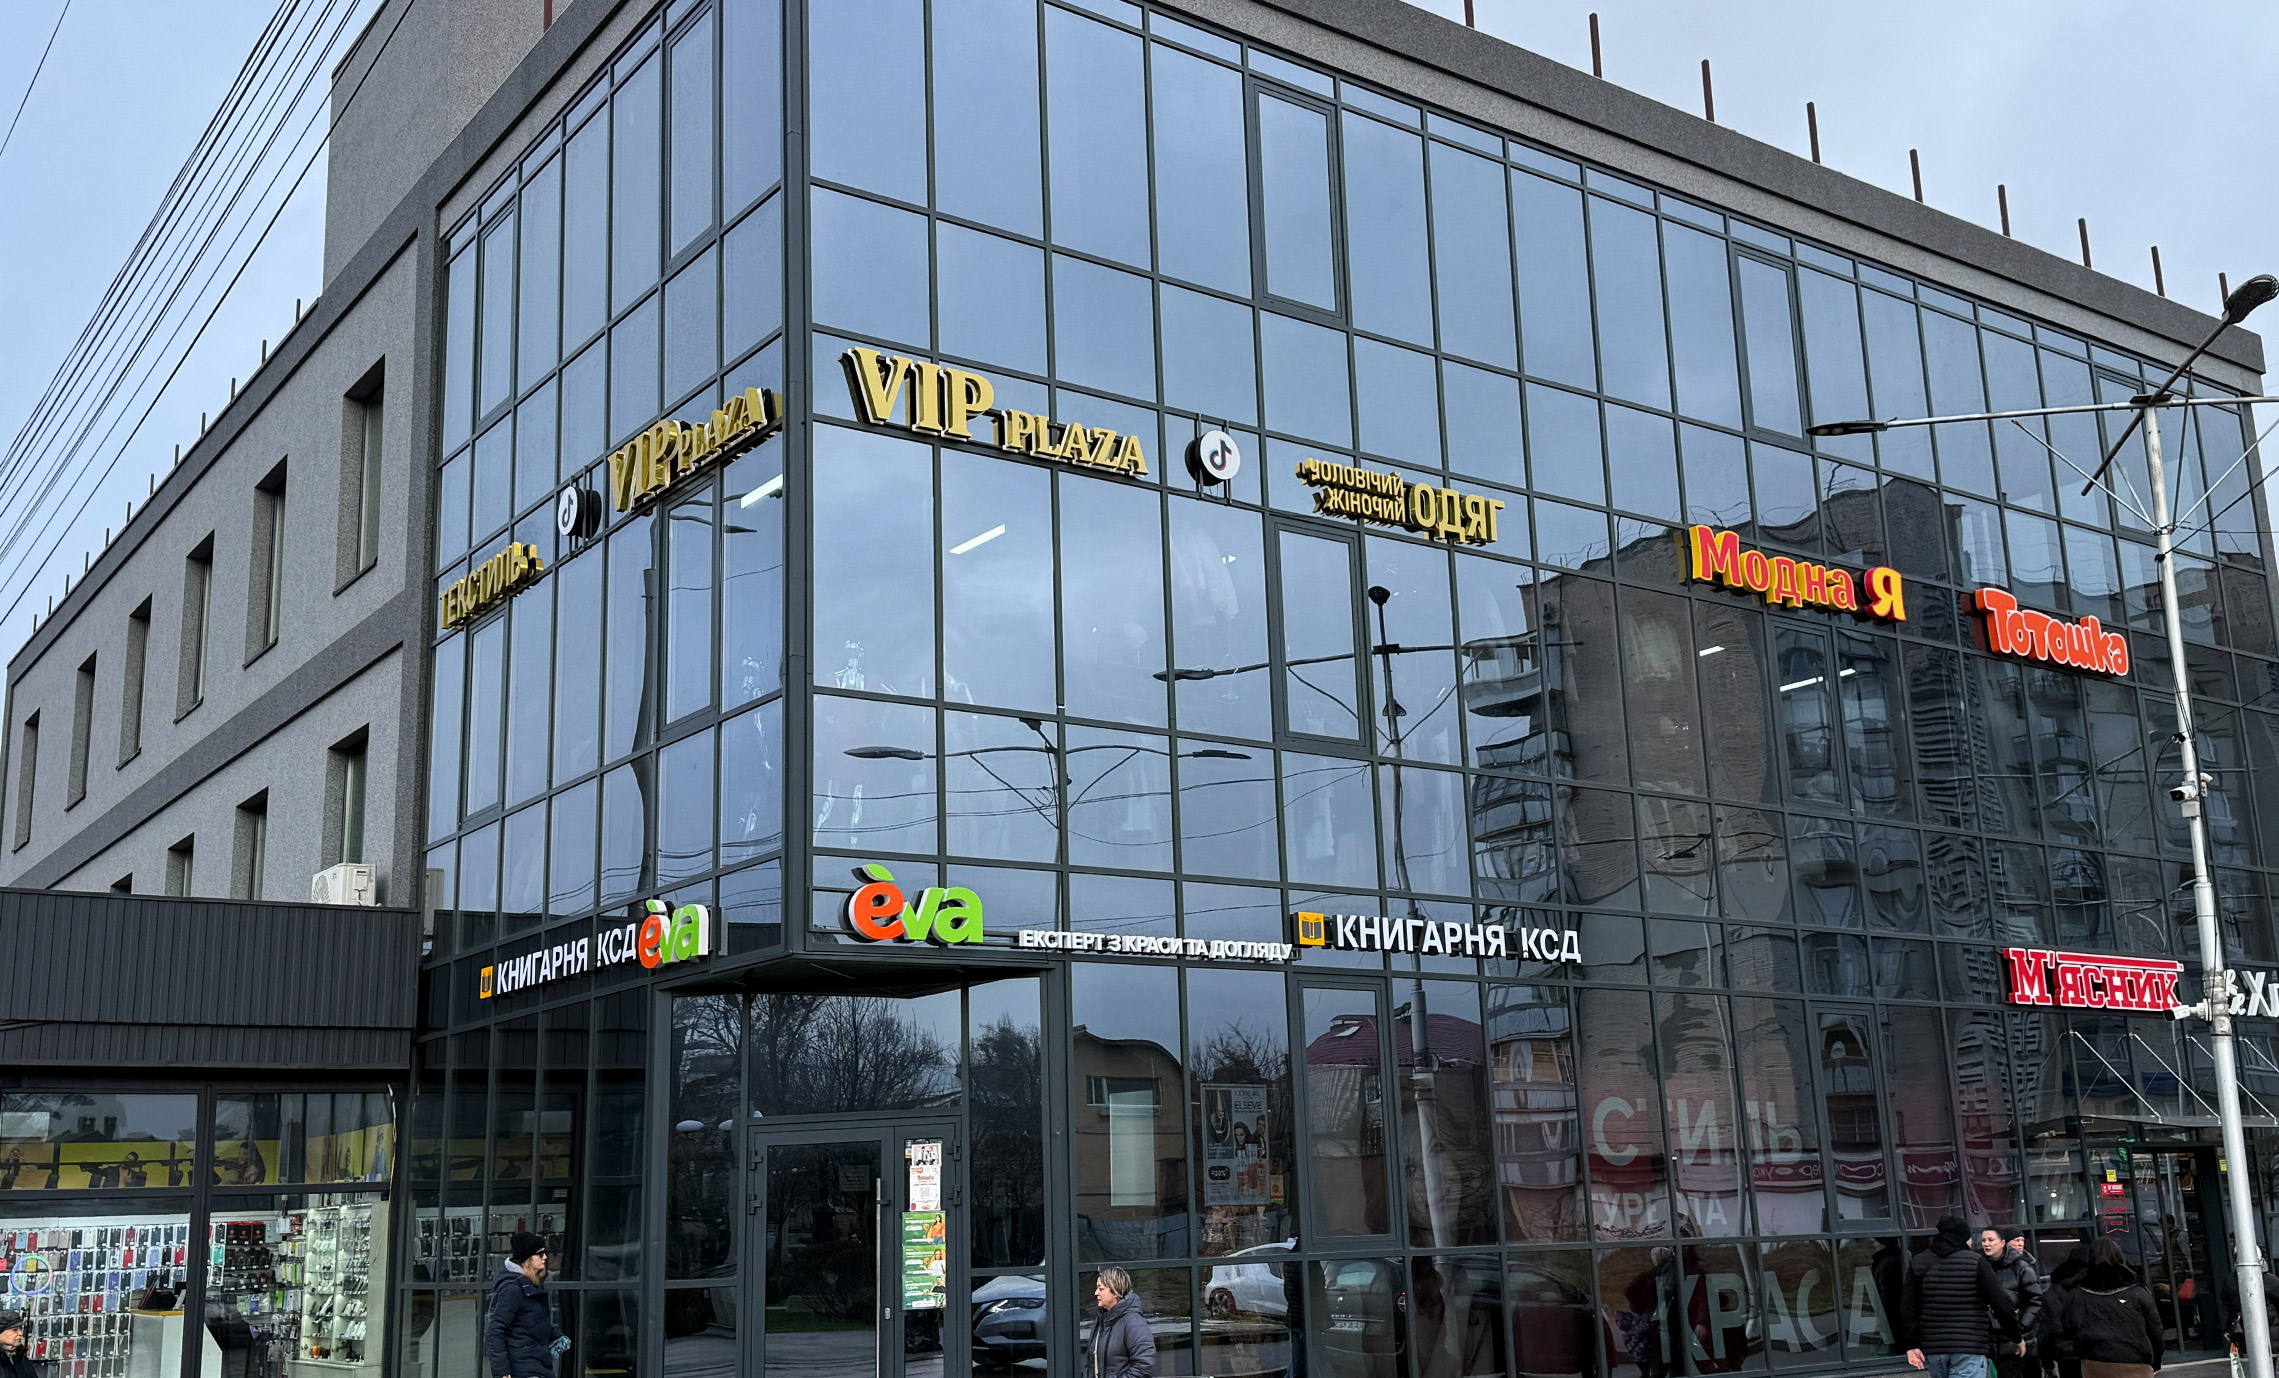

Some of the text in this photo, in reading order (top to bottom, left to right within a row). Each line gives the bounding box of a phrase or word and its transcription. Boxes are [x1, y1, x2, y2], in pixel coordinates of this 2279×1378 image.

[844, 346, 1150, 478] VIP PLAZA
[608, 386, 768, 512] VIP PLAZA
[1308, 458, 1405, 498] ЧОЛОВІЧИЙ
[1326, 486, 1406, 523] ЖІНОЧИЙ
[1411, 482, 1506, 544] ОДЯГ
[440, 541, 530, 630] ТЕКСТИЛЬ
[1689, 524, 1907, 622] Модна Я
[1975, 587, 2129, 677] Тотошка
[496, 923, 637, 995] КНИГАРНЯ КСД
[1018, 929, 1293, 961] ЕКСПЕРТ З КРАСИ ТА ДОГЛЯДУ
[1335, 914, 1582, 963] КНИГАРНЯ КСД
[2003, 947, 2183, 1011] М'ЯСНИК
[1234, 1101, 1262, 1111] ELSEVE
[1655, 1266, 1896, 1364] КРАСА
